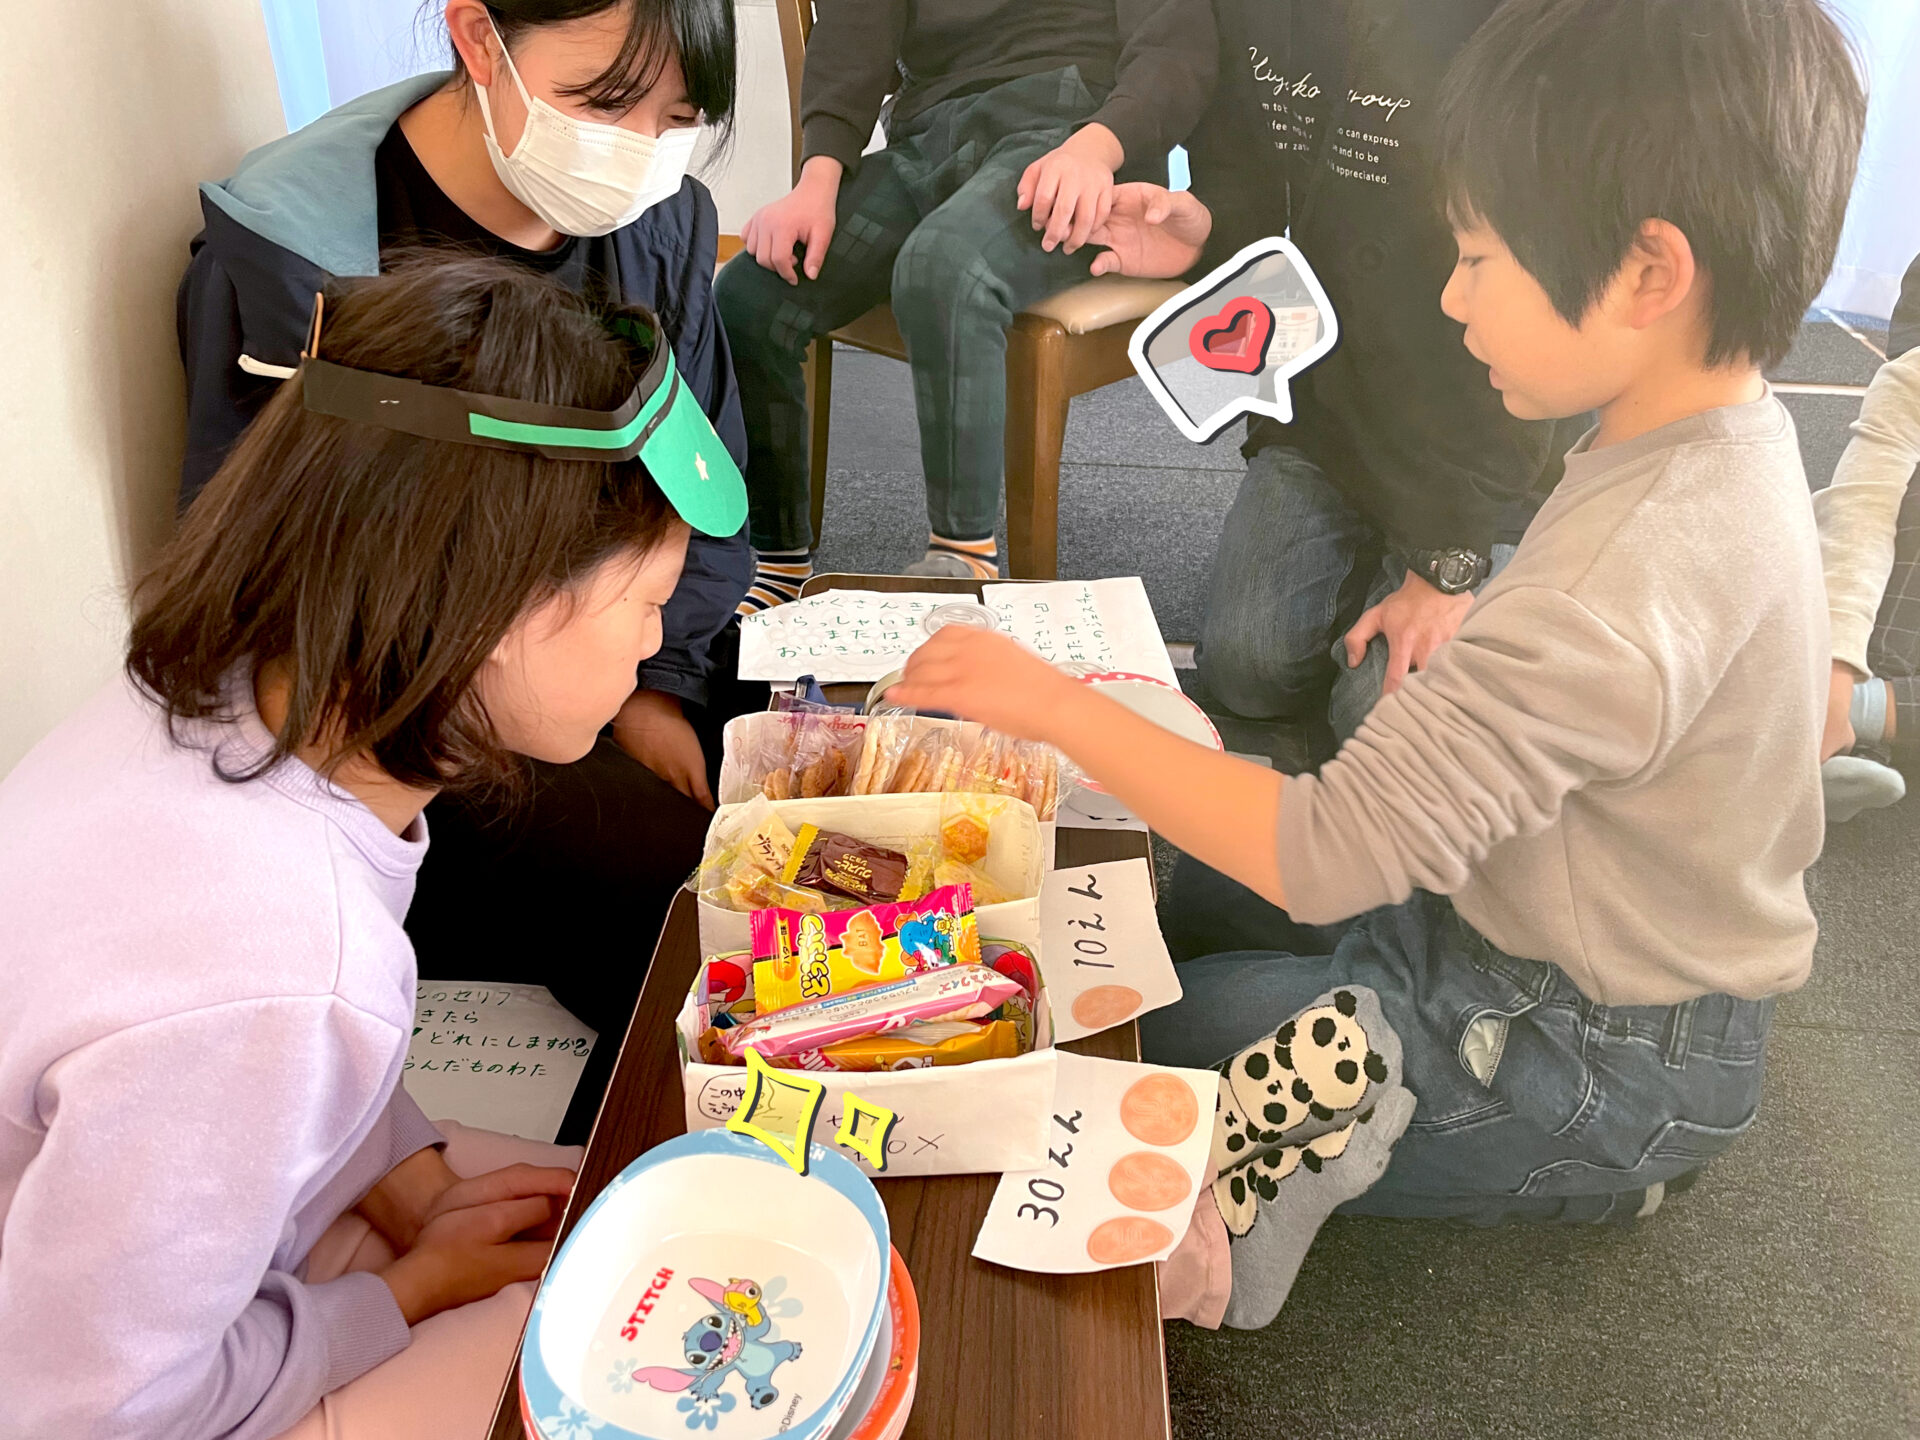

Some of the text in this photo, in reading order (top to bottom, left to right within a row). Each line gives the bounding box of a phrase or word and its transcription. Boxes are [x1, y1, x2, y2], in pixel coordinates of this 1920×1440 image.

[1346, 89, 1412, 123] roup
[1346, 128, 1361, 140] can
[1362, 131, 1400, 148] express
[1355, 150, 1365, 161] to
[1367, 151, 1380, 164] be
[825, 628, 900, 640] または
[834, 859, 873, 879] クリスピー
[857, 928, 868, 947] BAT
[797, 912, 831, 998] どうぶつ
[619, 1266, 675, 1342] STITCH
